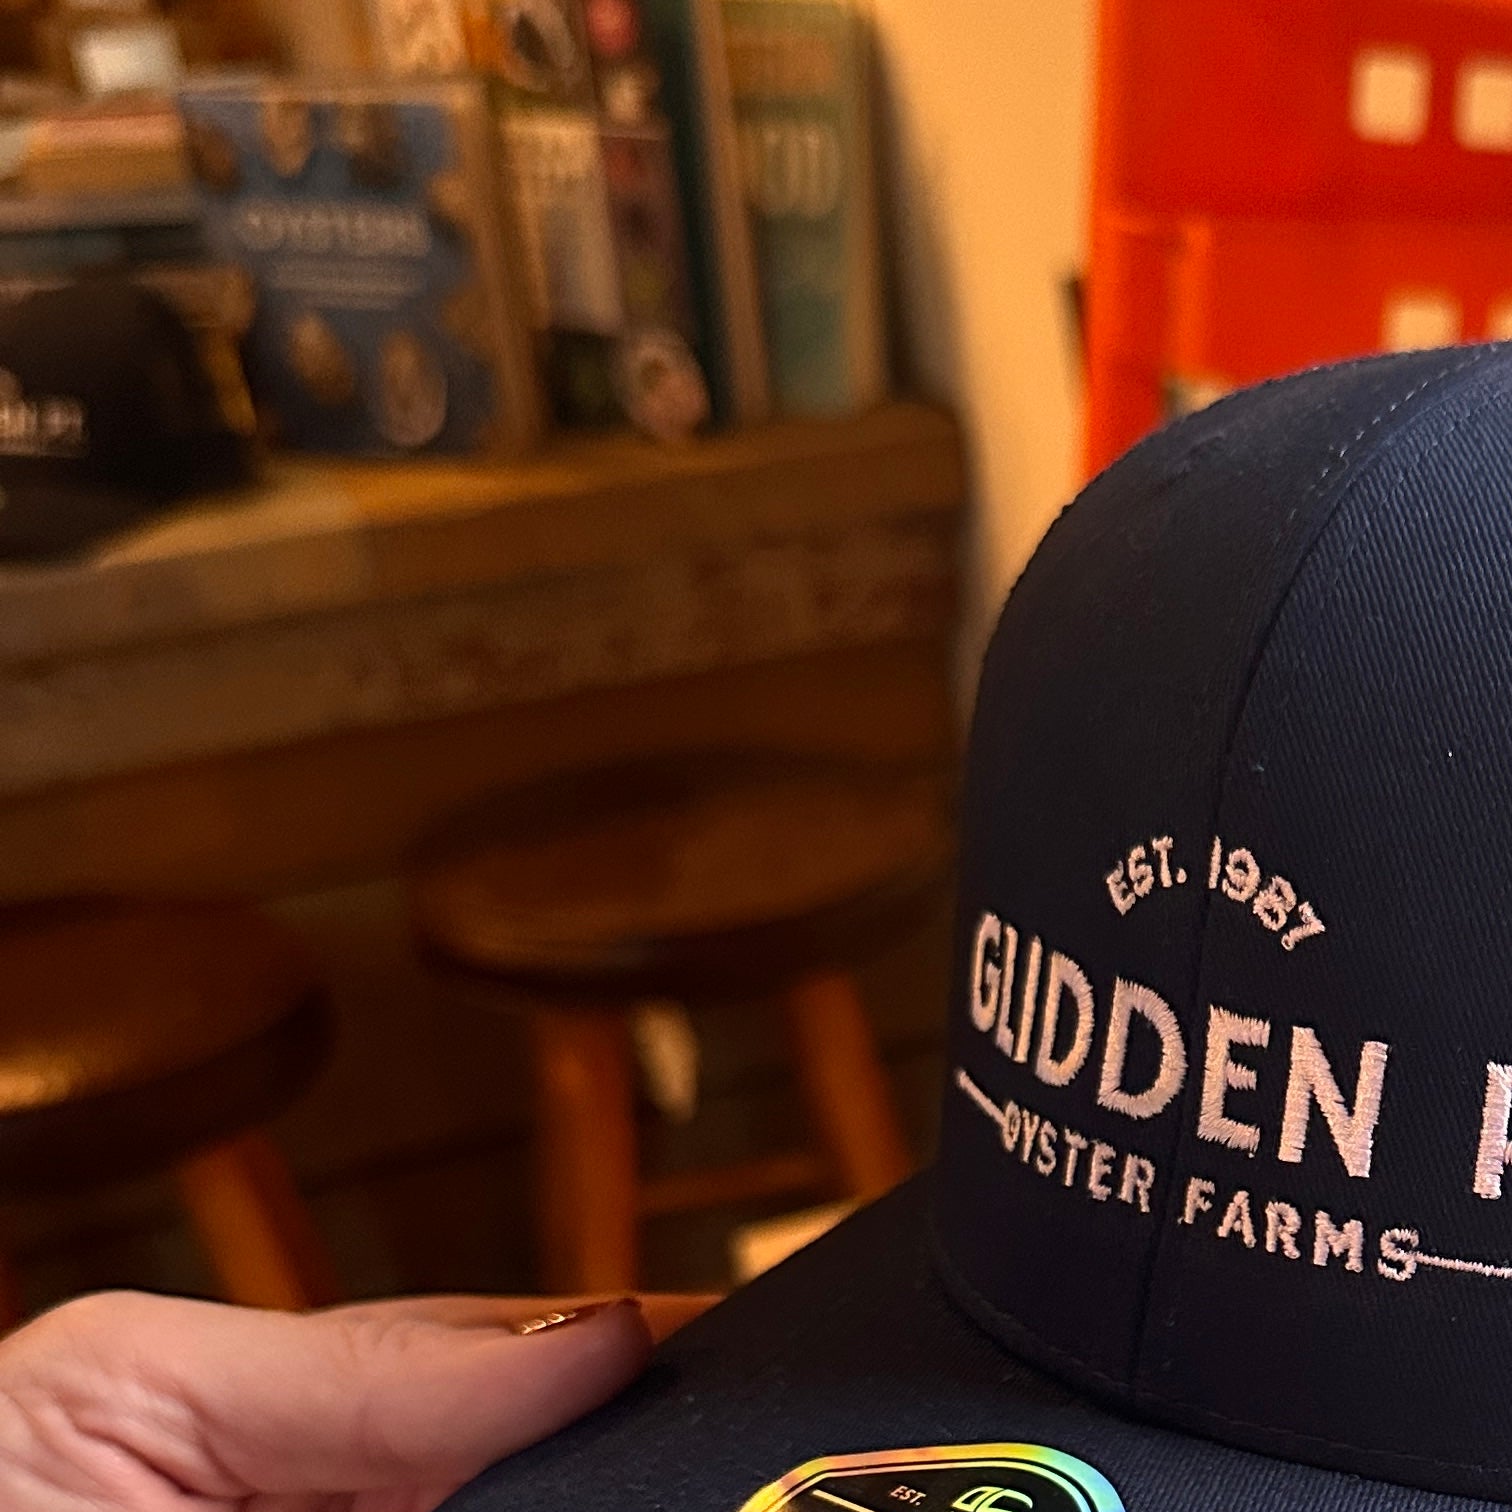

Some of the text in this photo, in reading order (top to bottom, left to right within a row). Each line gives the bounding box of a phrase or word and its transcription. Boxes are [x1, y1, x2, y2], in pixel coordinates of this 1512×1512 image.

[1104, 835, 1326, 951] EST. 1987
[970, 911, 1389, 1179] GLIDDEN
[1003, 1099, 1420, 1281] OYSTER FARMS
[889, 1485, 926, 1505] EST.
